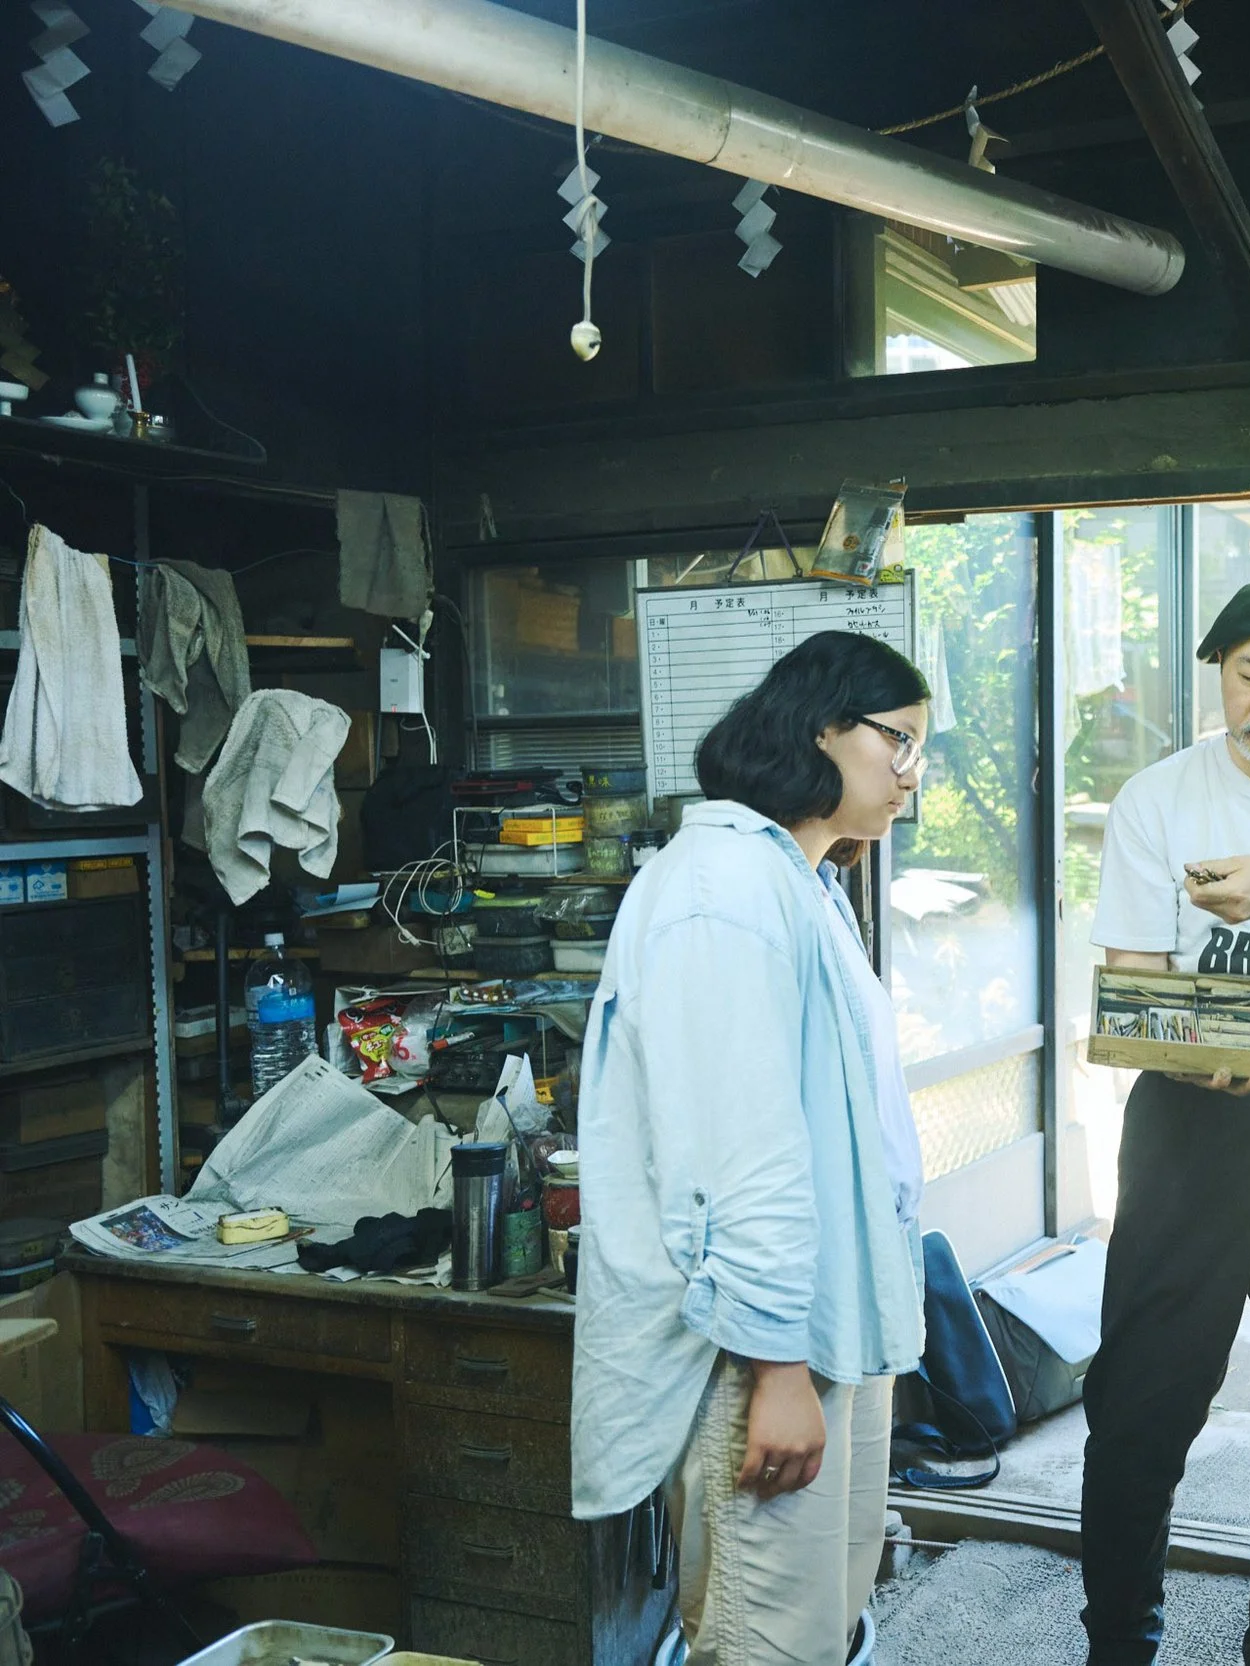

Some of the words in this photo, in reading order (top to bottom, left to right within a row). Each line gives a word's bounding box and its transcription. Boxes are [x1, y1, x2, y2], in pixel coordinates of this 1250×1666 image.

[819, 591, 828, 602] 月
[845, 589, 879, 601] 予定表
[690, 600, 698, 611] 月
[715, 598, 745, 609] 予定表
